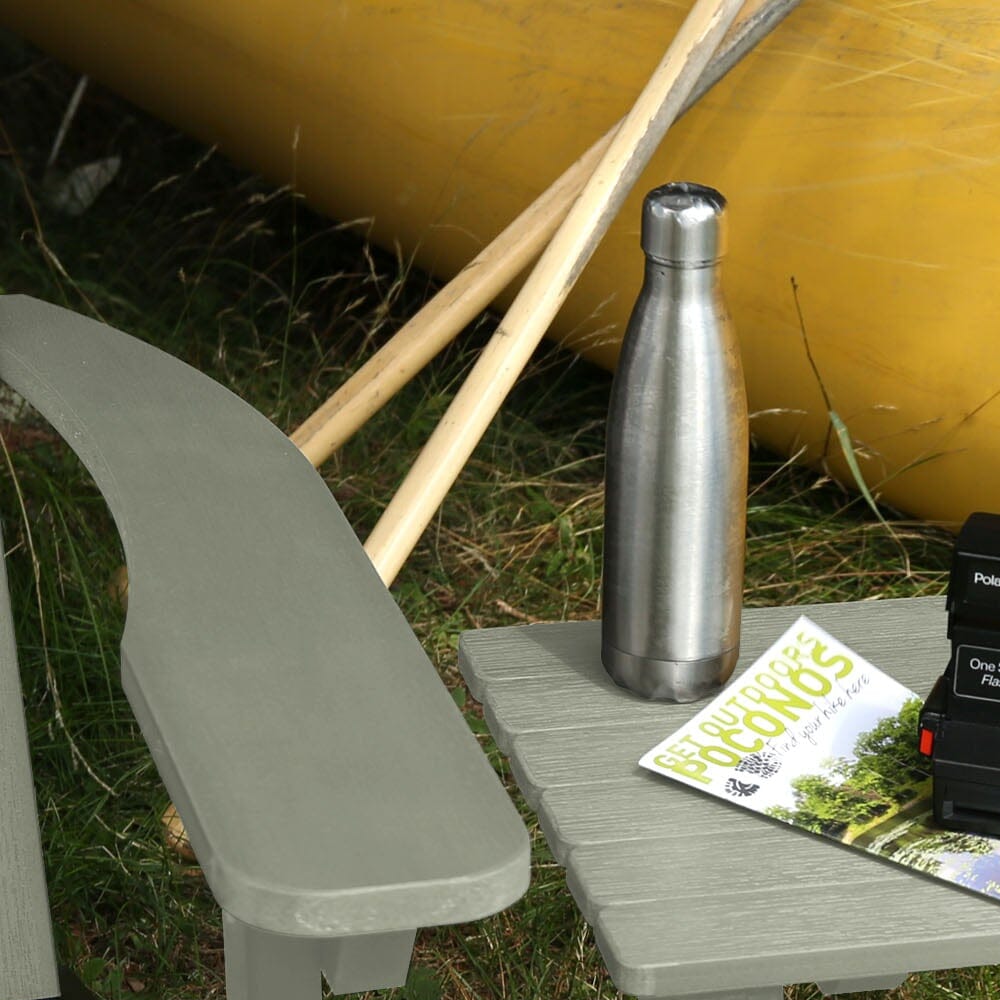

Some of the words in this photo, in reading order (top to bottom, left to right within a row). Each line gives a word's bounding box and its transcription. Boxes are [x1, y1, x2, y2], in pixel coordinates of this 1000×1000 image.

[969, 658, 997, 673] One
[671, 640, 854, 784] POCONOS
[799, 715, 822, 746] your
[653, 734, 703, 769] GET
